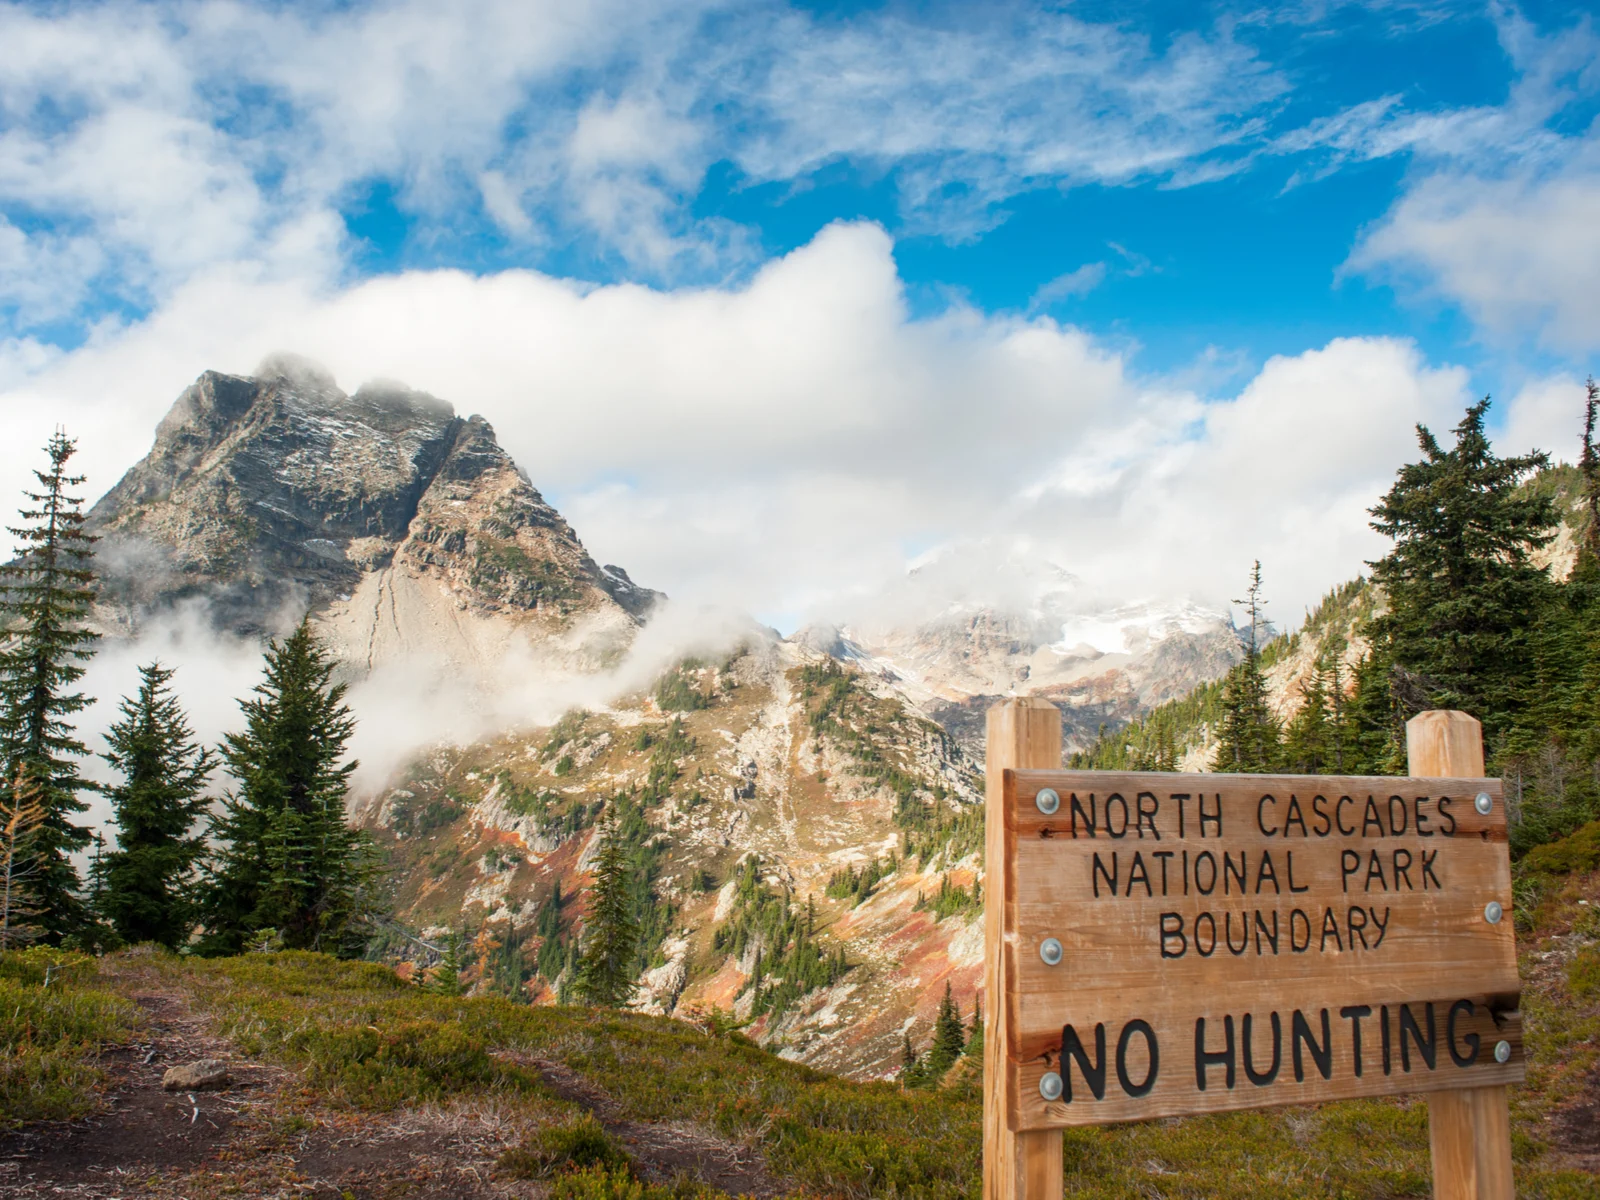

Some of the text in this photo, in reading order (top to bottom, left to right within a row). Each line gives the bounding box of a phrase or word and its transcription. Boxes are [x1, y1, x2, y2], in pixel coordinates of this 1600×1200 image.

[1070, 792, 1457, 841] NORTH CASCADES
[1092, 848, 1442, 898] NATIONAL PARK
[1160, 906, 1390, 959] BOUNDARY
[1060, 999, 1480, 1103] NO HUNTING
